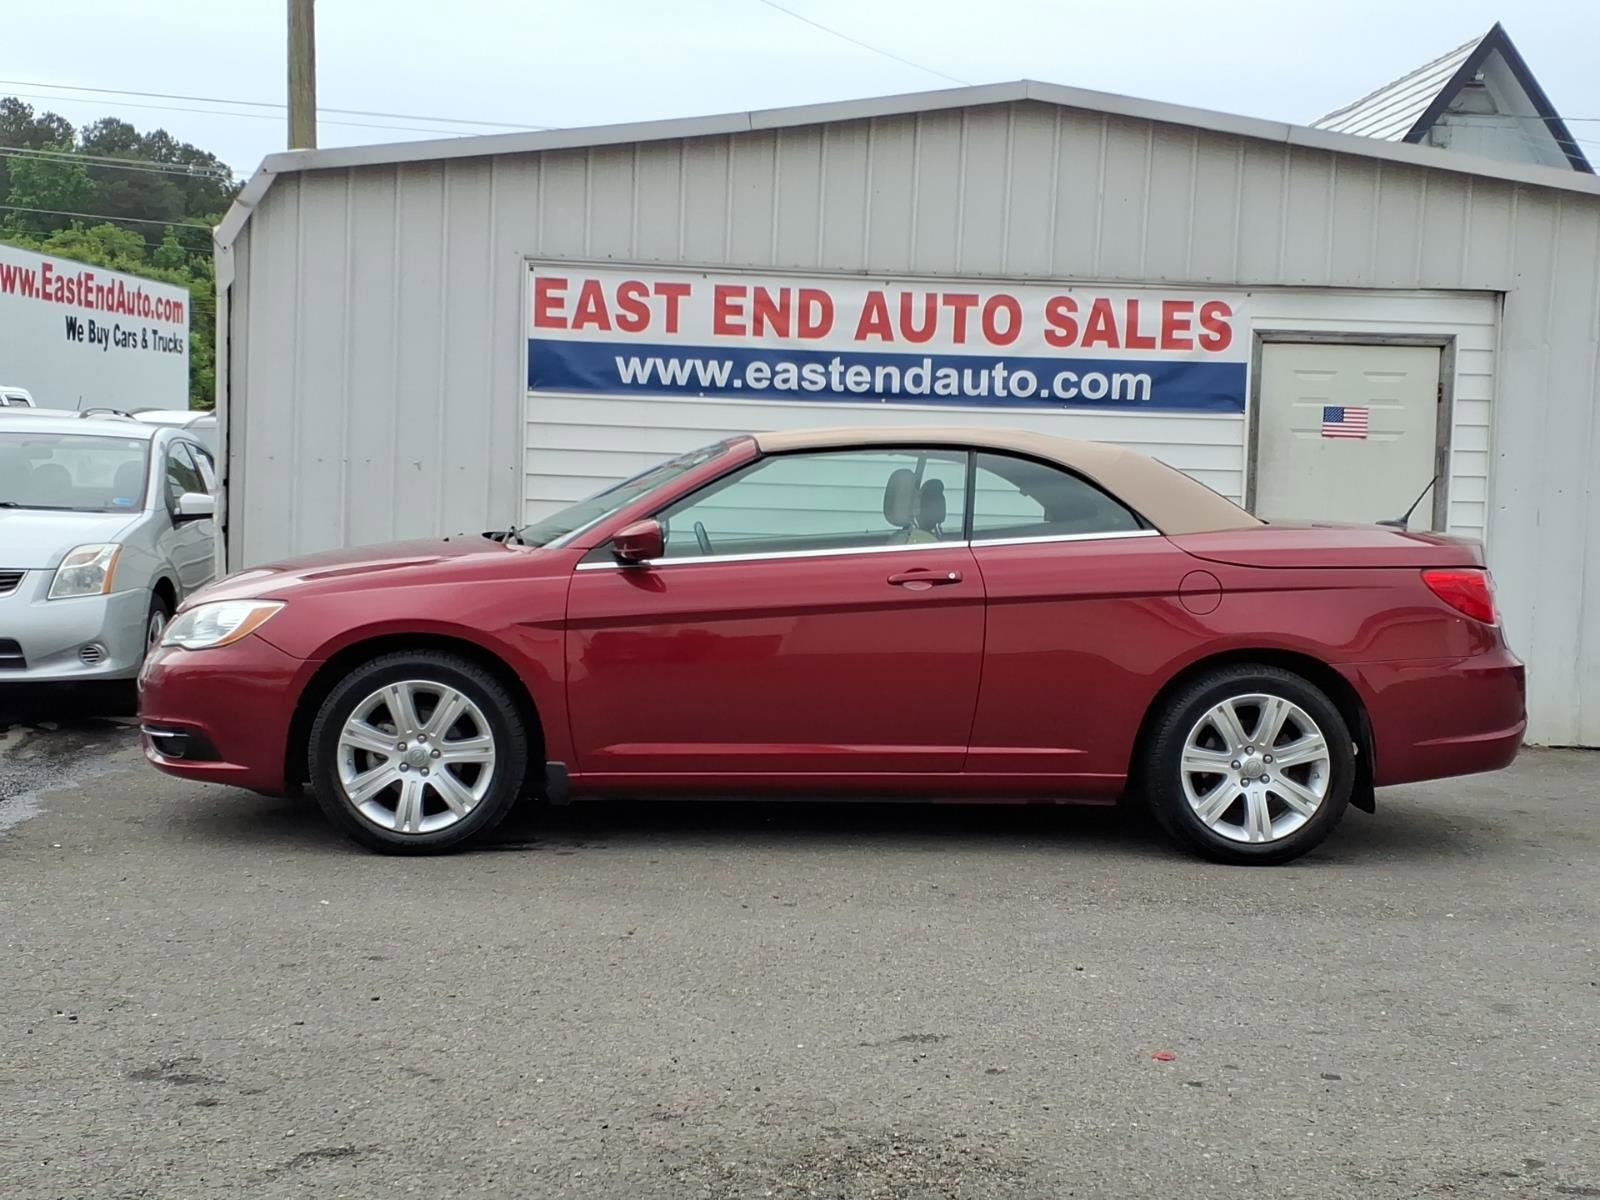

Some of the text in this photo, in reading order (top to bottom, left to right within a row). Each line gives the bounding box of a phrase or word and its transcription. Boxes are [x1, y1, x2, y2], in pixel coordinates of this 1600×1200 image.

[65, 315, 184, 354] We Buy Cars & Trucks
[533, 276, 1233, 353] EAST END AUTO SALES
[615, 355, 1152, 401] www.eastendauto.com
